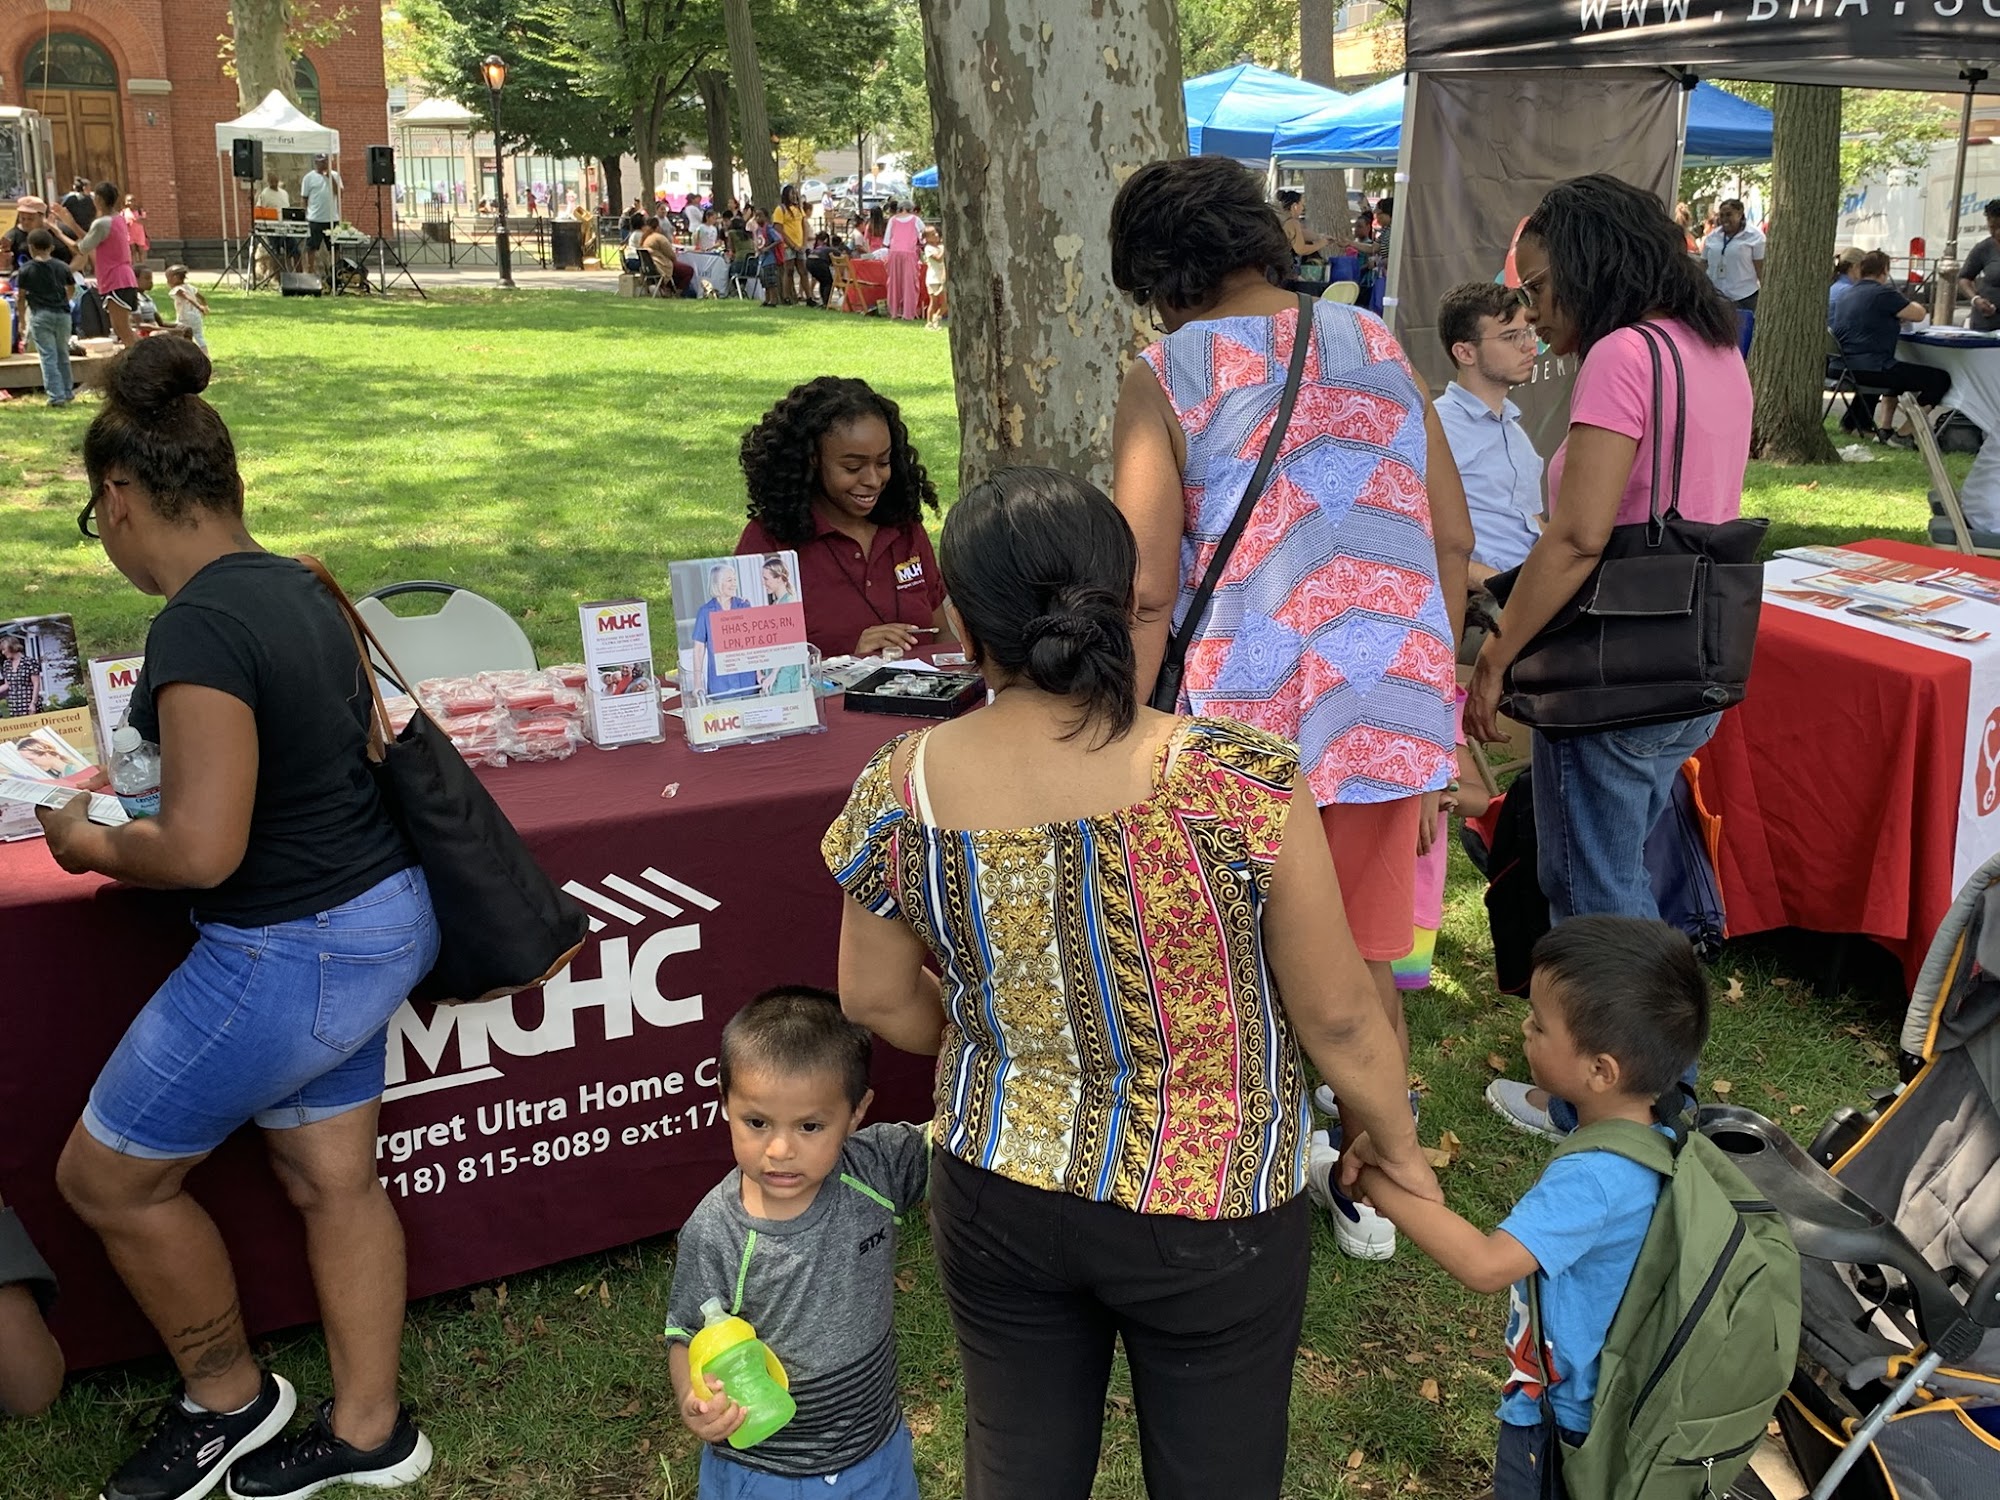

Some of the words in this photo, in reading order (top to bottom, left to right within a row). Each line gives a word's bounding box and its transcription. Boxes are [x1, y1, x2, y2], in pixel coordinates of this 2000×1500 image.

[598, 612, 642, 632] MUHC
[721, 622, 751, 635] HHA'S,
[752, 618, 778, 631] PCA'S,
[780, 617, 795, 628] RN,
[723, 640, 744, 650] LPN,
[745, 636, 756, 646] PT
[757, 635, 765, 645] &
[766, 633, 778, 643] OT
[40, 712, 81, 726] Directed
[703, 715, 741, 734] MUHC
[375, 1115, 467, 1163] rgret
[476, 1097, 567, 1136] Ultra
[579, 1071, 685, 1114] Home
[694, 1057, 721, 1087] C
[457, 1127, 611, 1184] 815-8089
